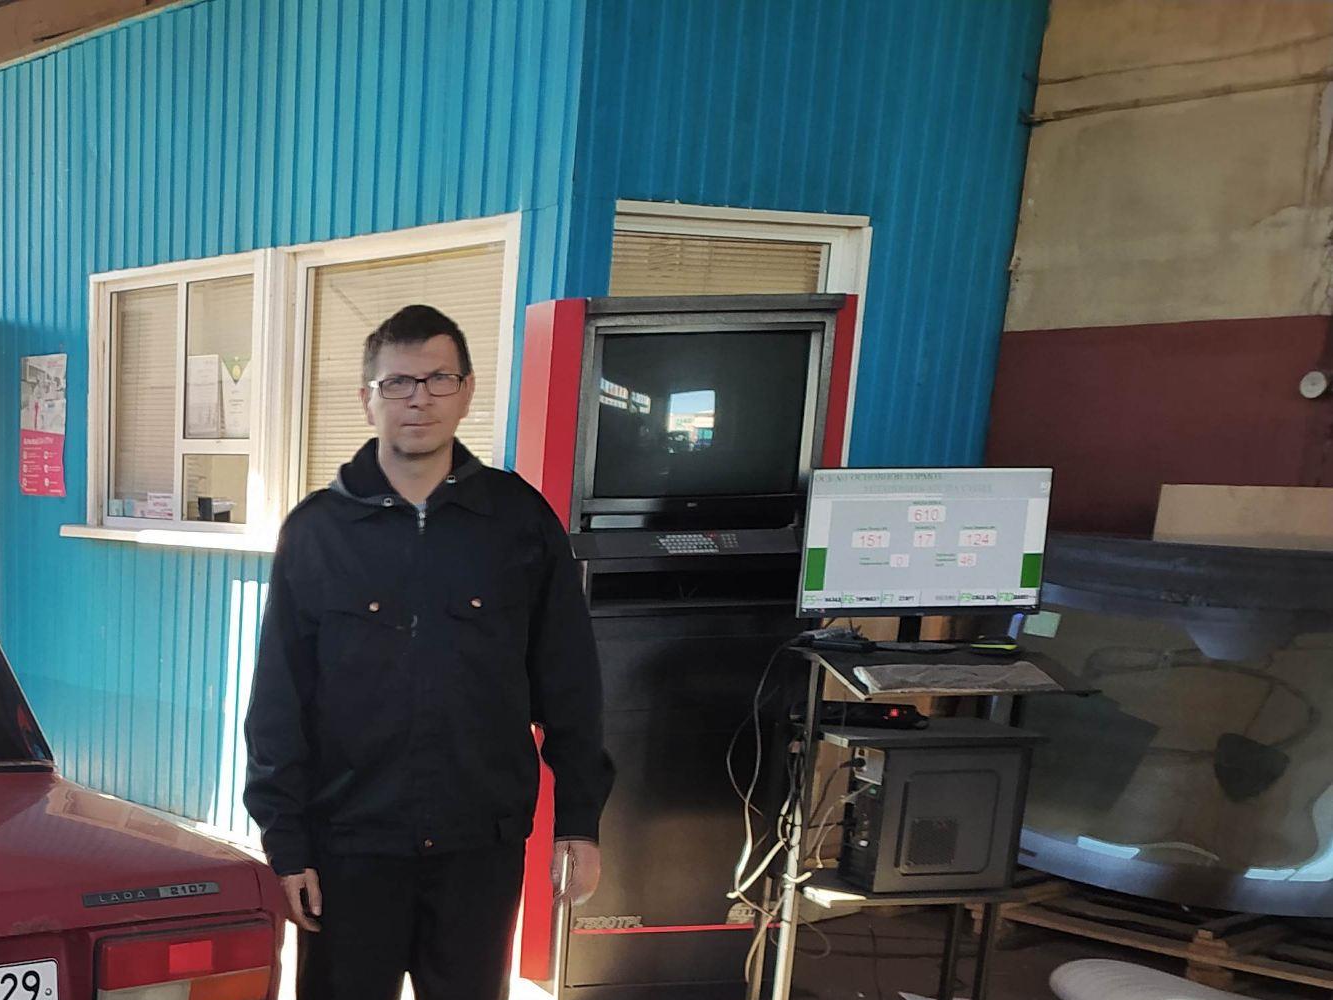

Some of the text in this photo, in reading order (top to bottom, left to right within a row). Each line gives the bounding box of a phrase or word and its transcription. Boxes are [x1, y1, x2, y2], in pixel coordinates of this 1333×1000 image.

[913, 508, 940, 522] 610
[858, 535, 883, 547] 151
[917, 533, 934, 547] 17
[965, 532, 989, 546] 124
[99, 884, 208, 903] LADA 2107
